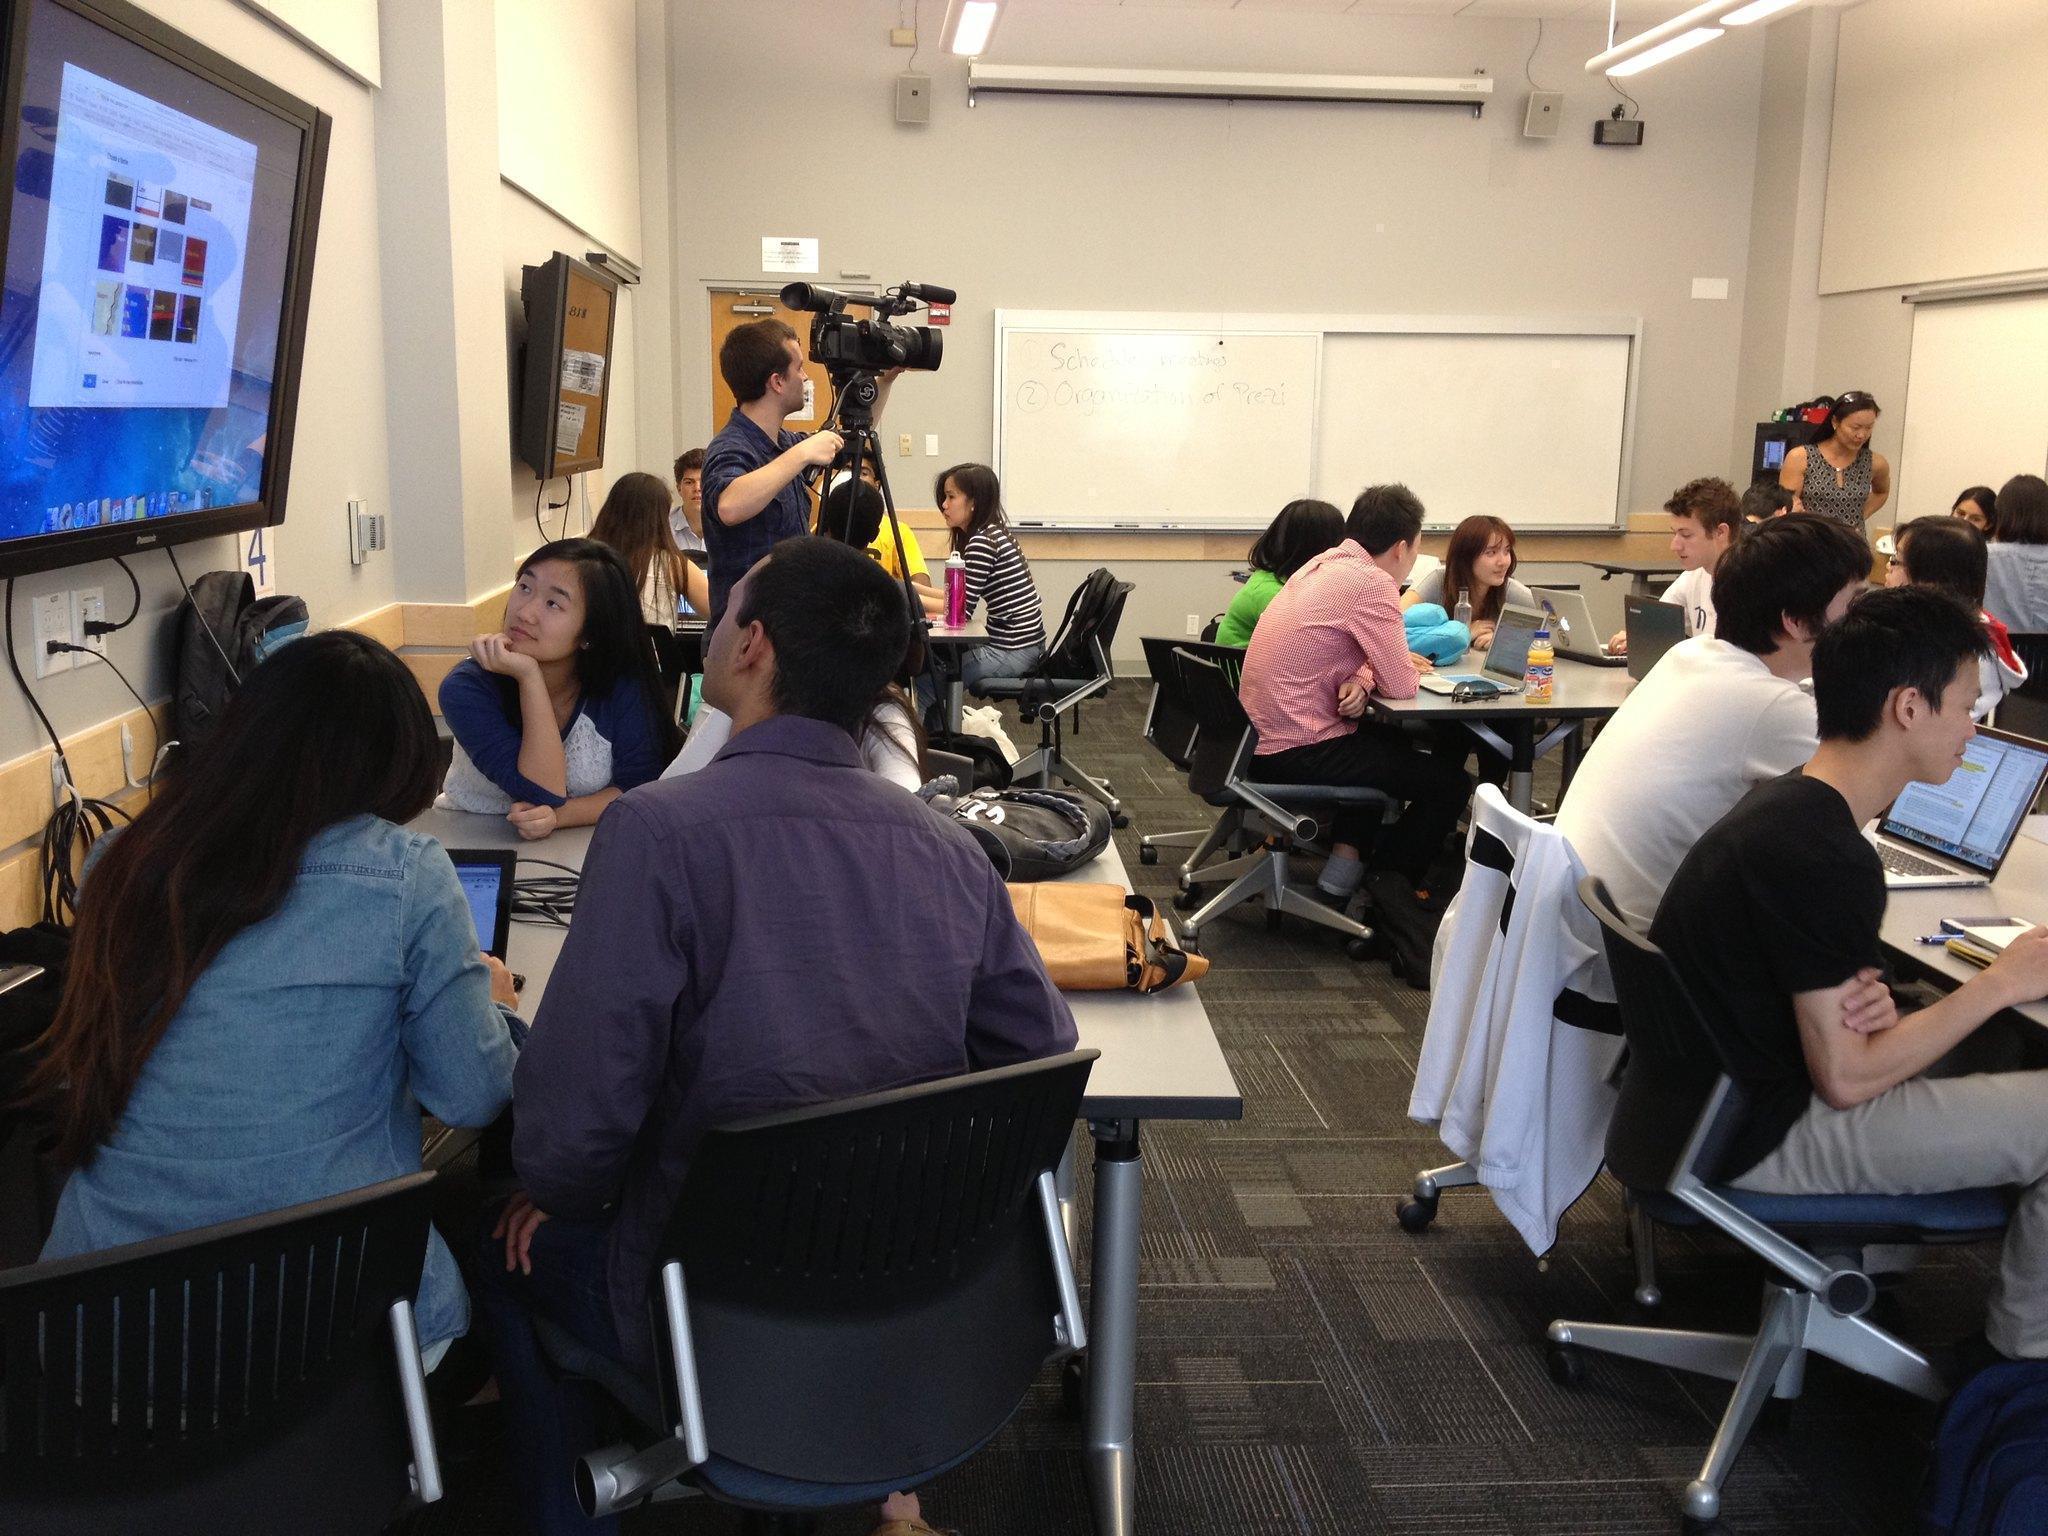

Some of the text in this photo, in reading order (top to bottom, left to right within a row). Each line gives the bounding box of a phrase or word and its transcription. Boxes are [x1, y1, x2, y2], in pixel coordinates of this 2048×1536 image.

[1202, 382, 1226, 405] of
[1232, 381, 1286, 406] Prezi
[247, 528, 267, 586] 4
